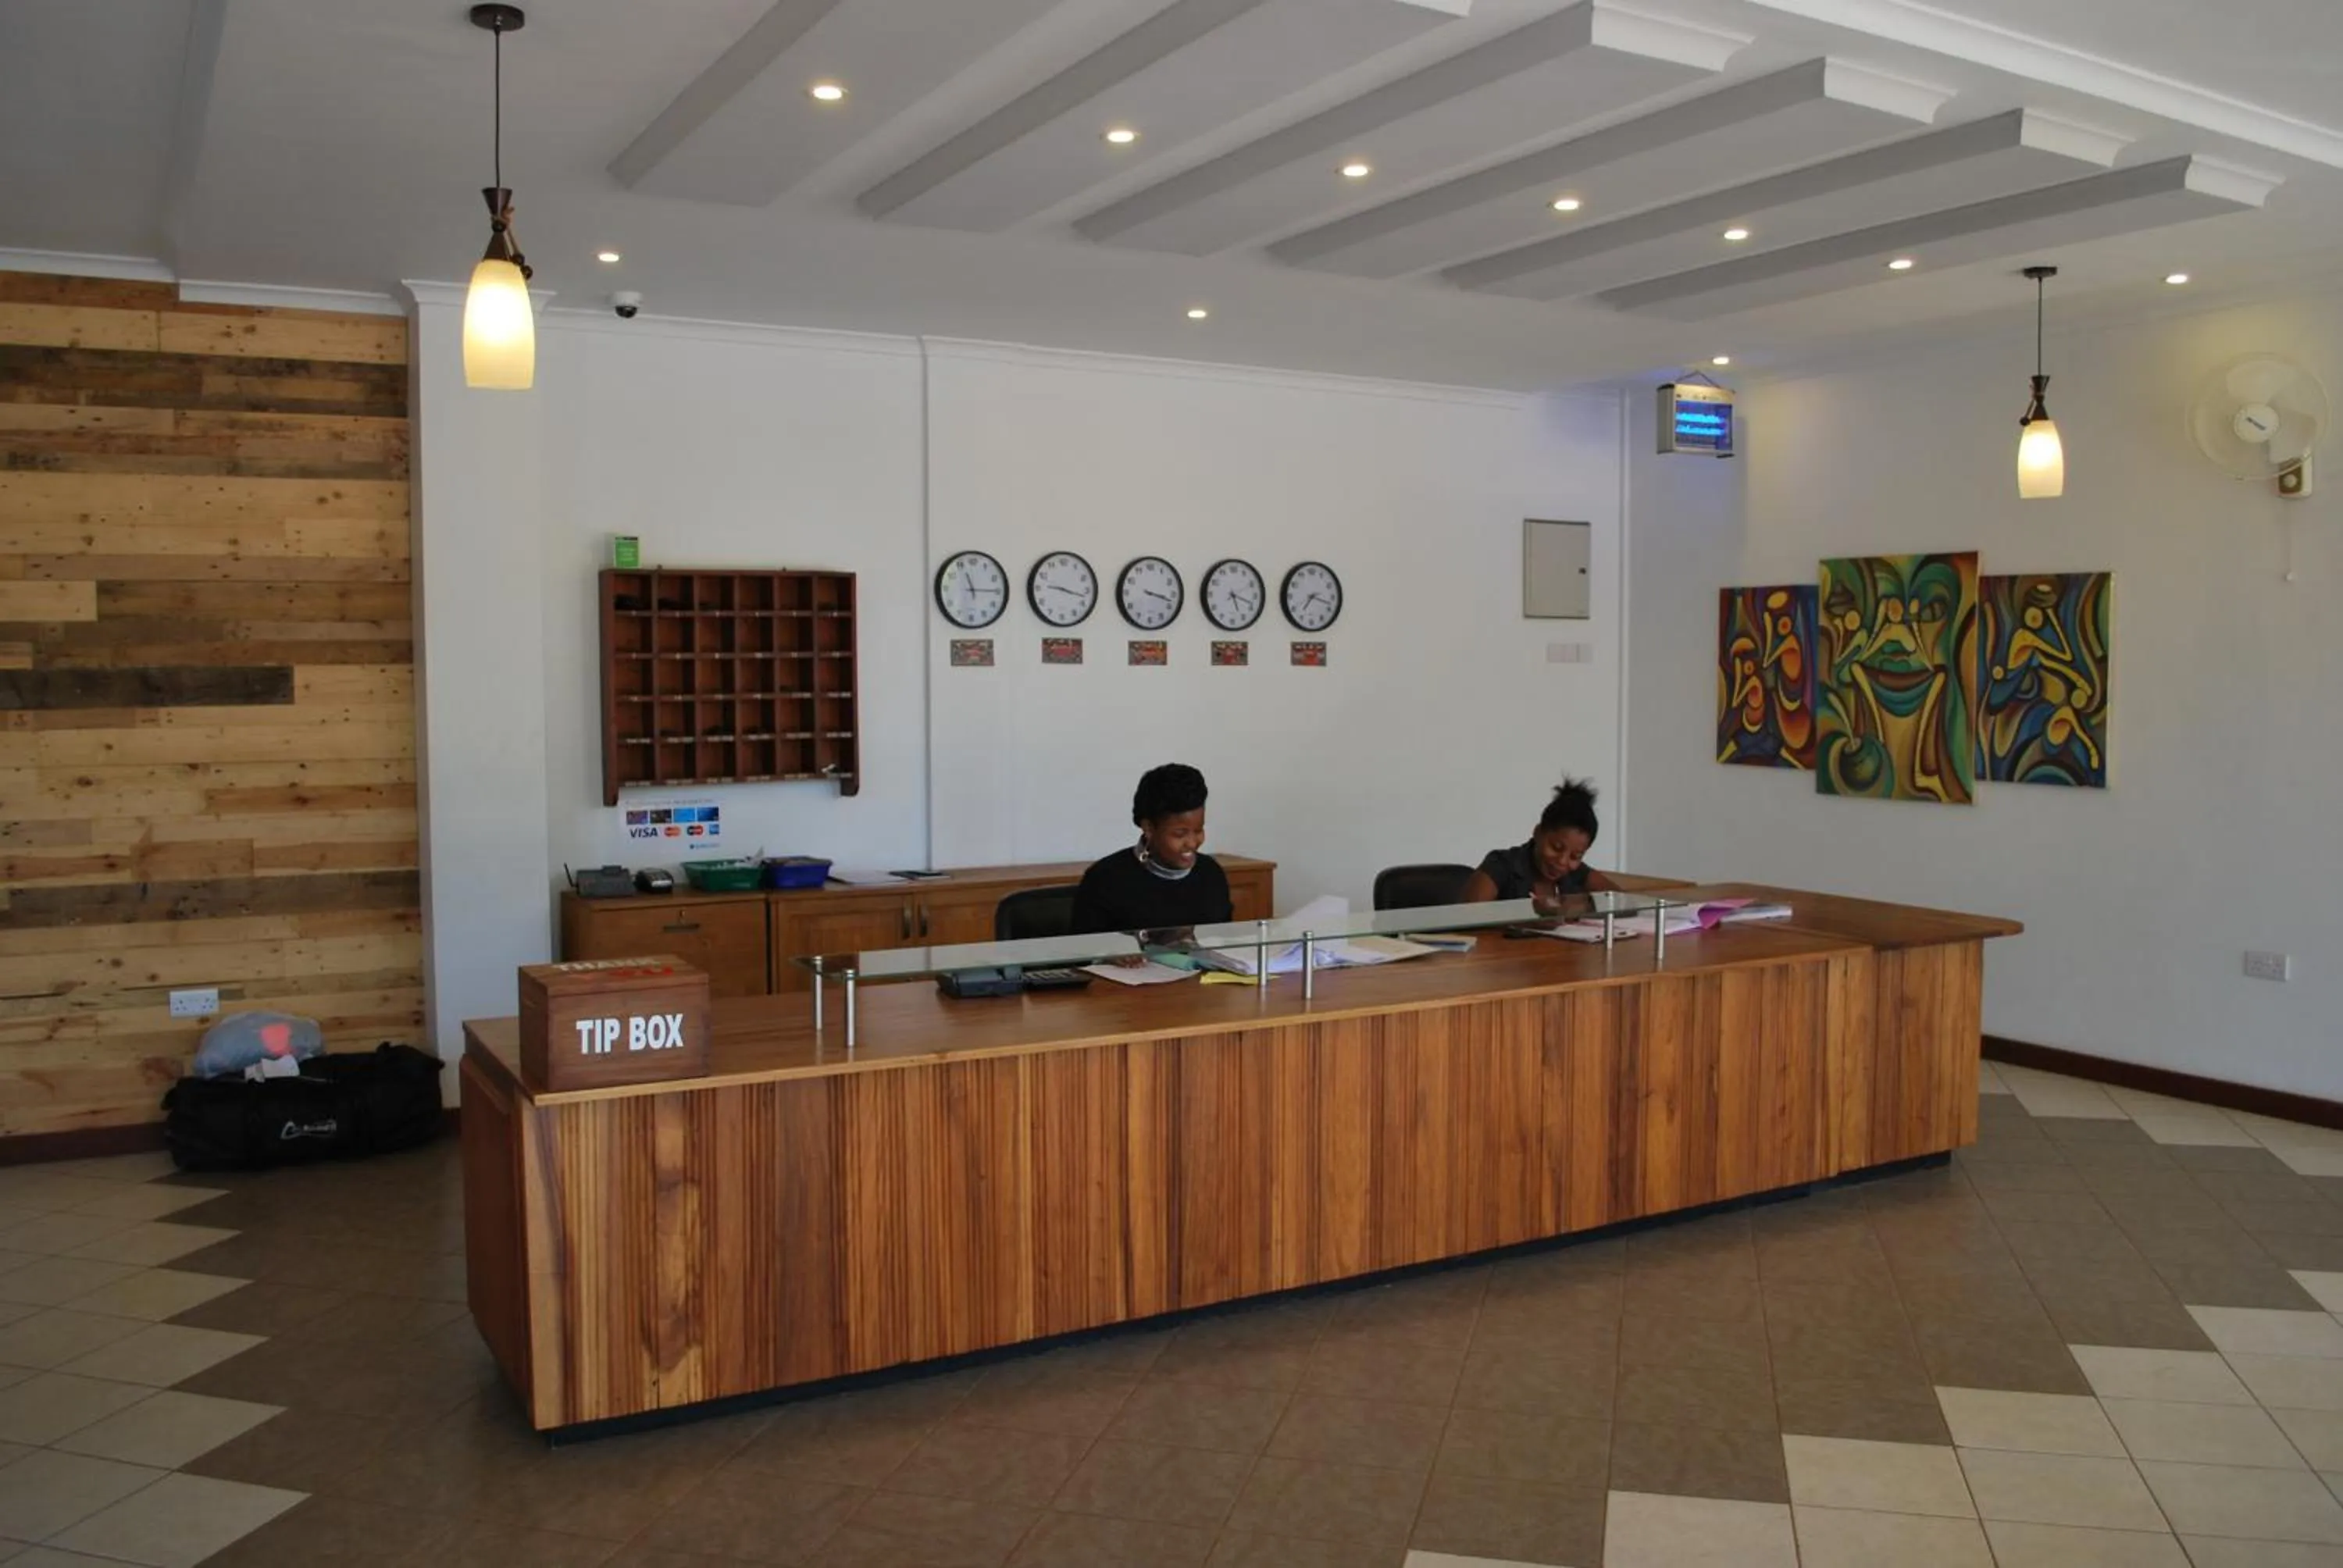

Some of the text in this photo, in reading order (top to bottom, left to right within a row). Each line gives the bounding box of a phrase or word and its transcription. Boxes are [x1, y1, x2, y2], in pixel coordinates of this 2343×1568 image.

[629, 827, 658, 838] VISA
[576, 1014, 684, 1054] TIP BOX
